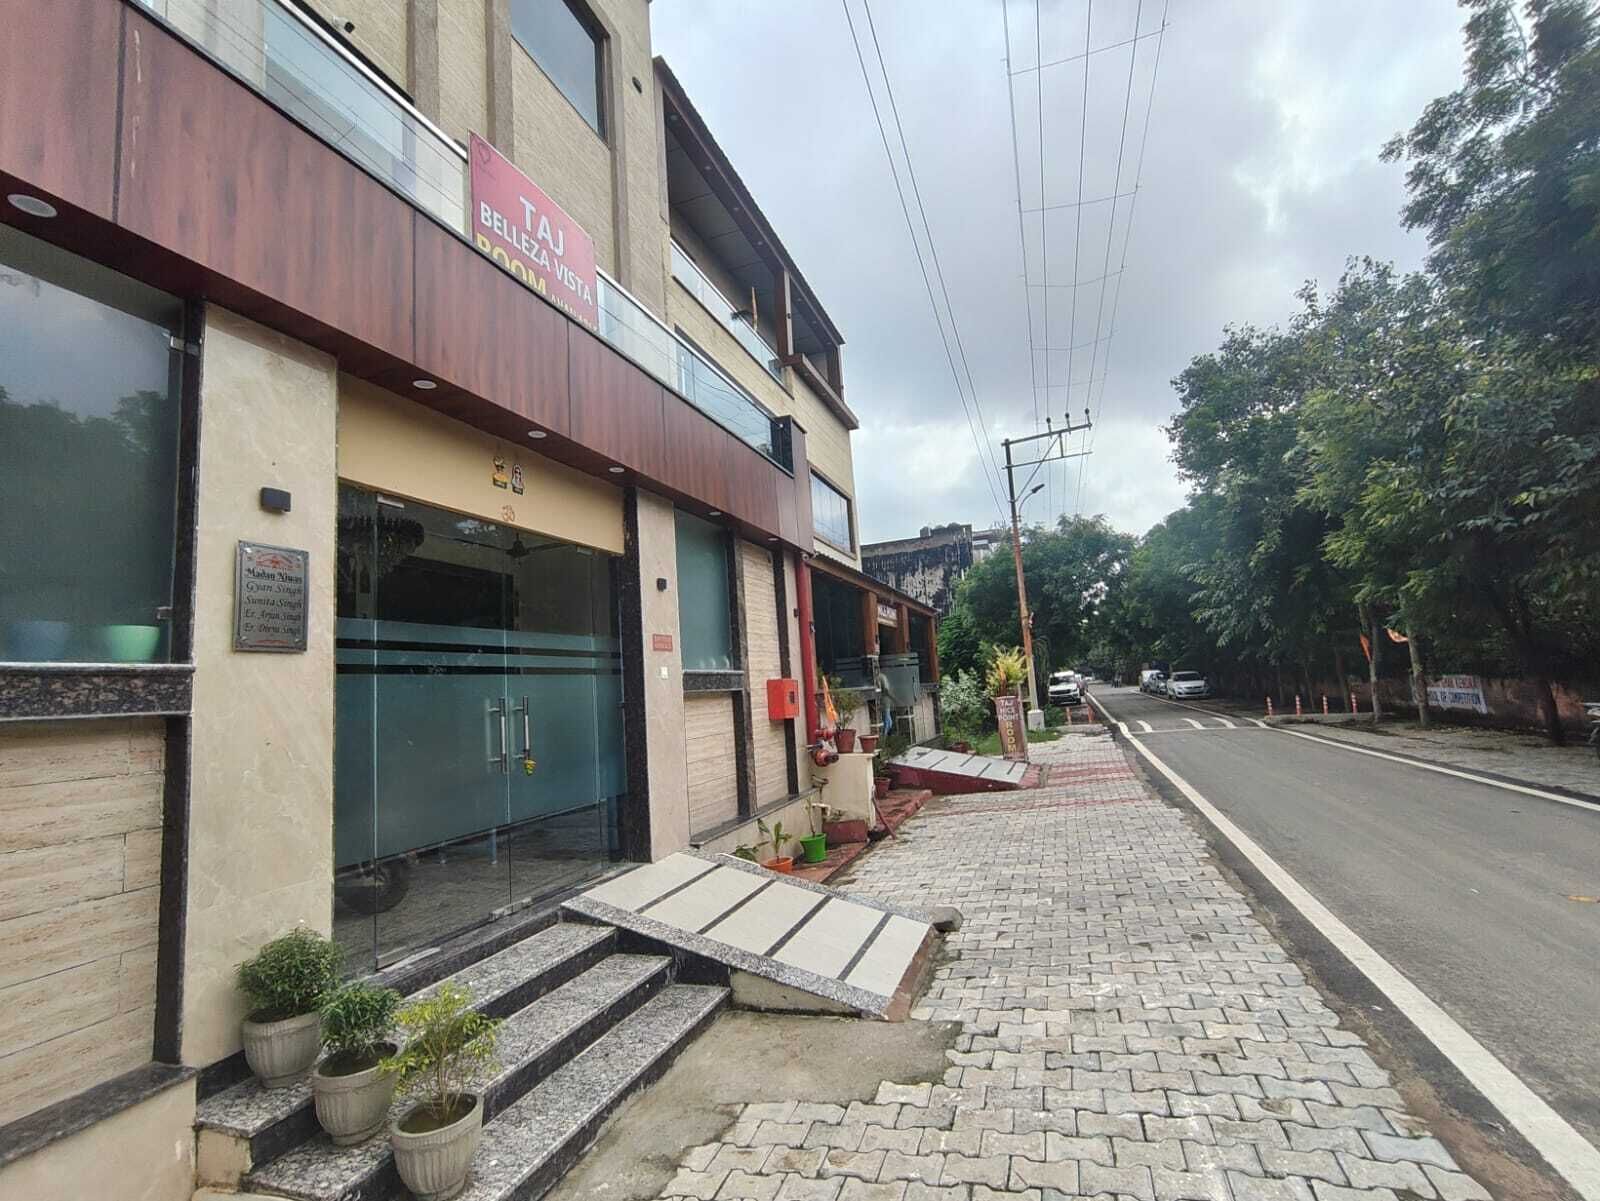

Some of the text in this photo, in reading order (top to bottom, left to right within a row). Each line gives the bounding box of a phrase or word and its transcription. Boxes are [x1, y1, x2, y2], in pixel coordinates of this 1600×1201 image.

[480, 200, 592, 305] BELLEZA VISTA
[519, 195, 564, 257] TAJ
